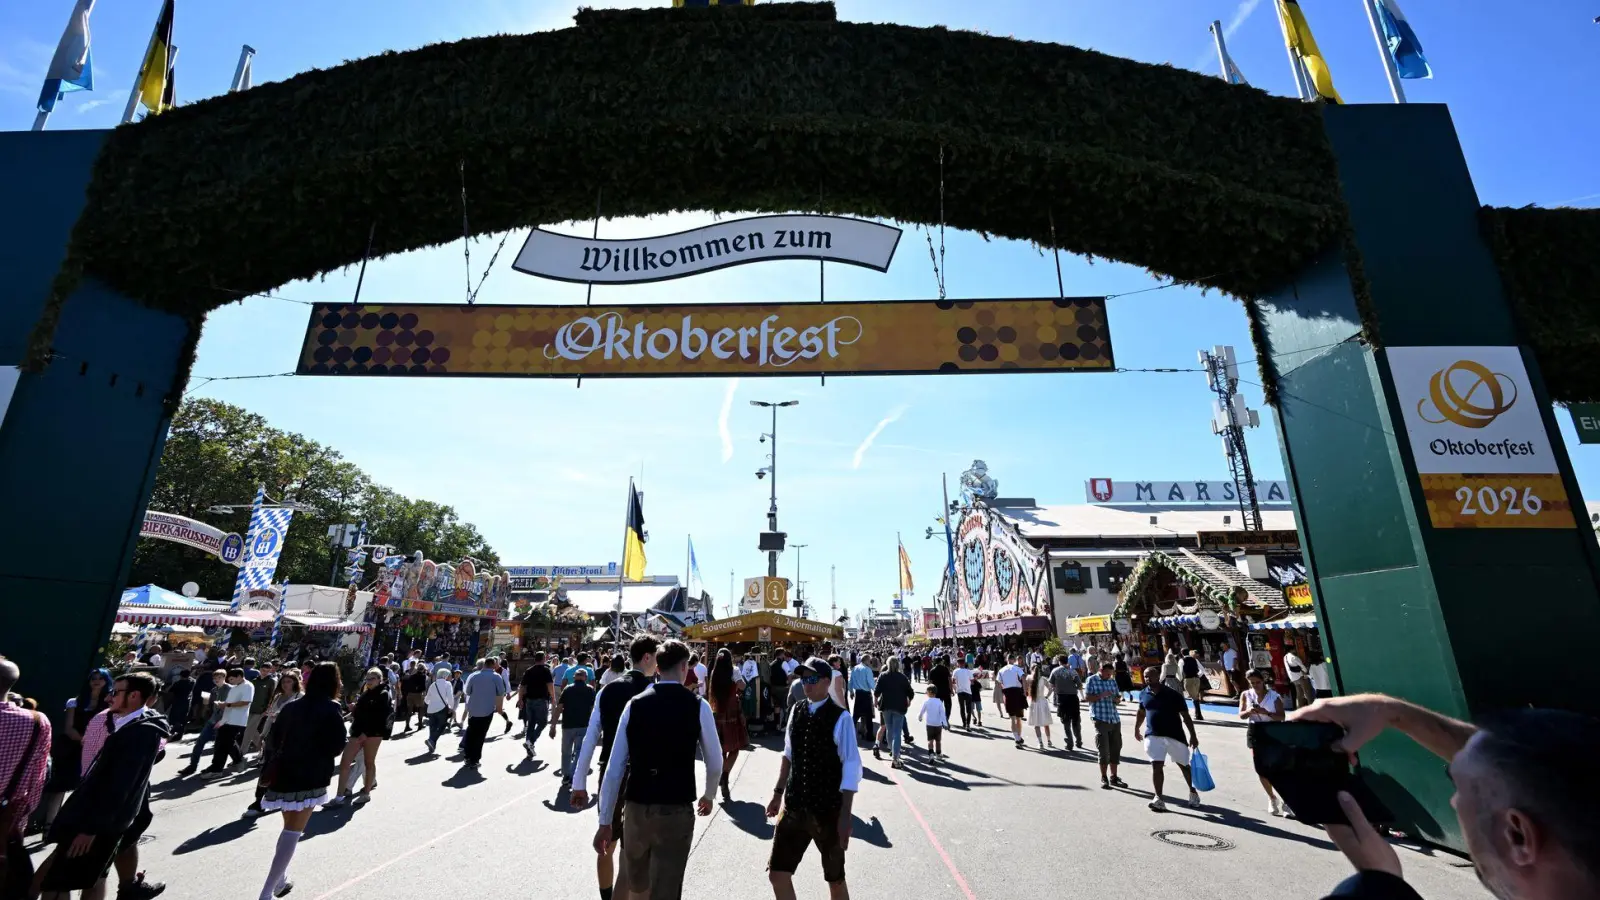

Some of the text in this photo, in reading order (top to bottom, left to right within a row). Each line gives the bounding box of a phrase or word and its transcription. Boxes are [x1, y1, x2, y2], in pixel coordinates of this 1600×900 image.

[579, 229, 832, 272] Willkommen zum
[543, 311, 862, 367] Oktoberfest
[1579, 416, 1600, 430] Ei
[1429, 438, 1535, 459] Oktoberfest
[1455, 486, 1542, 516] 2026
[141, 521, 221, 550] BIERKARUSSELL
[224, 546, 238, 559] HB
[1288, 586, 1311, 598] And
[702, 619, 742, 634] Souvenirs
[784, 617, 832, 634] Information
